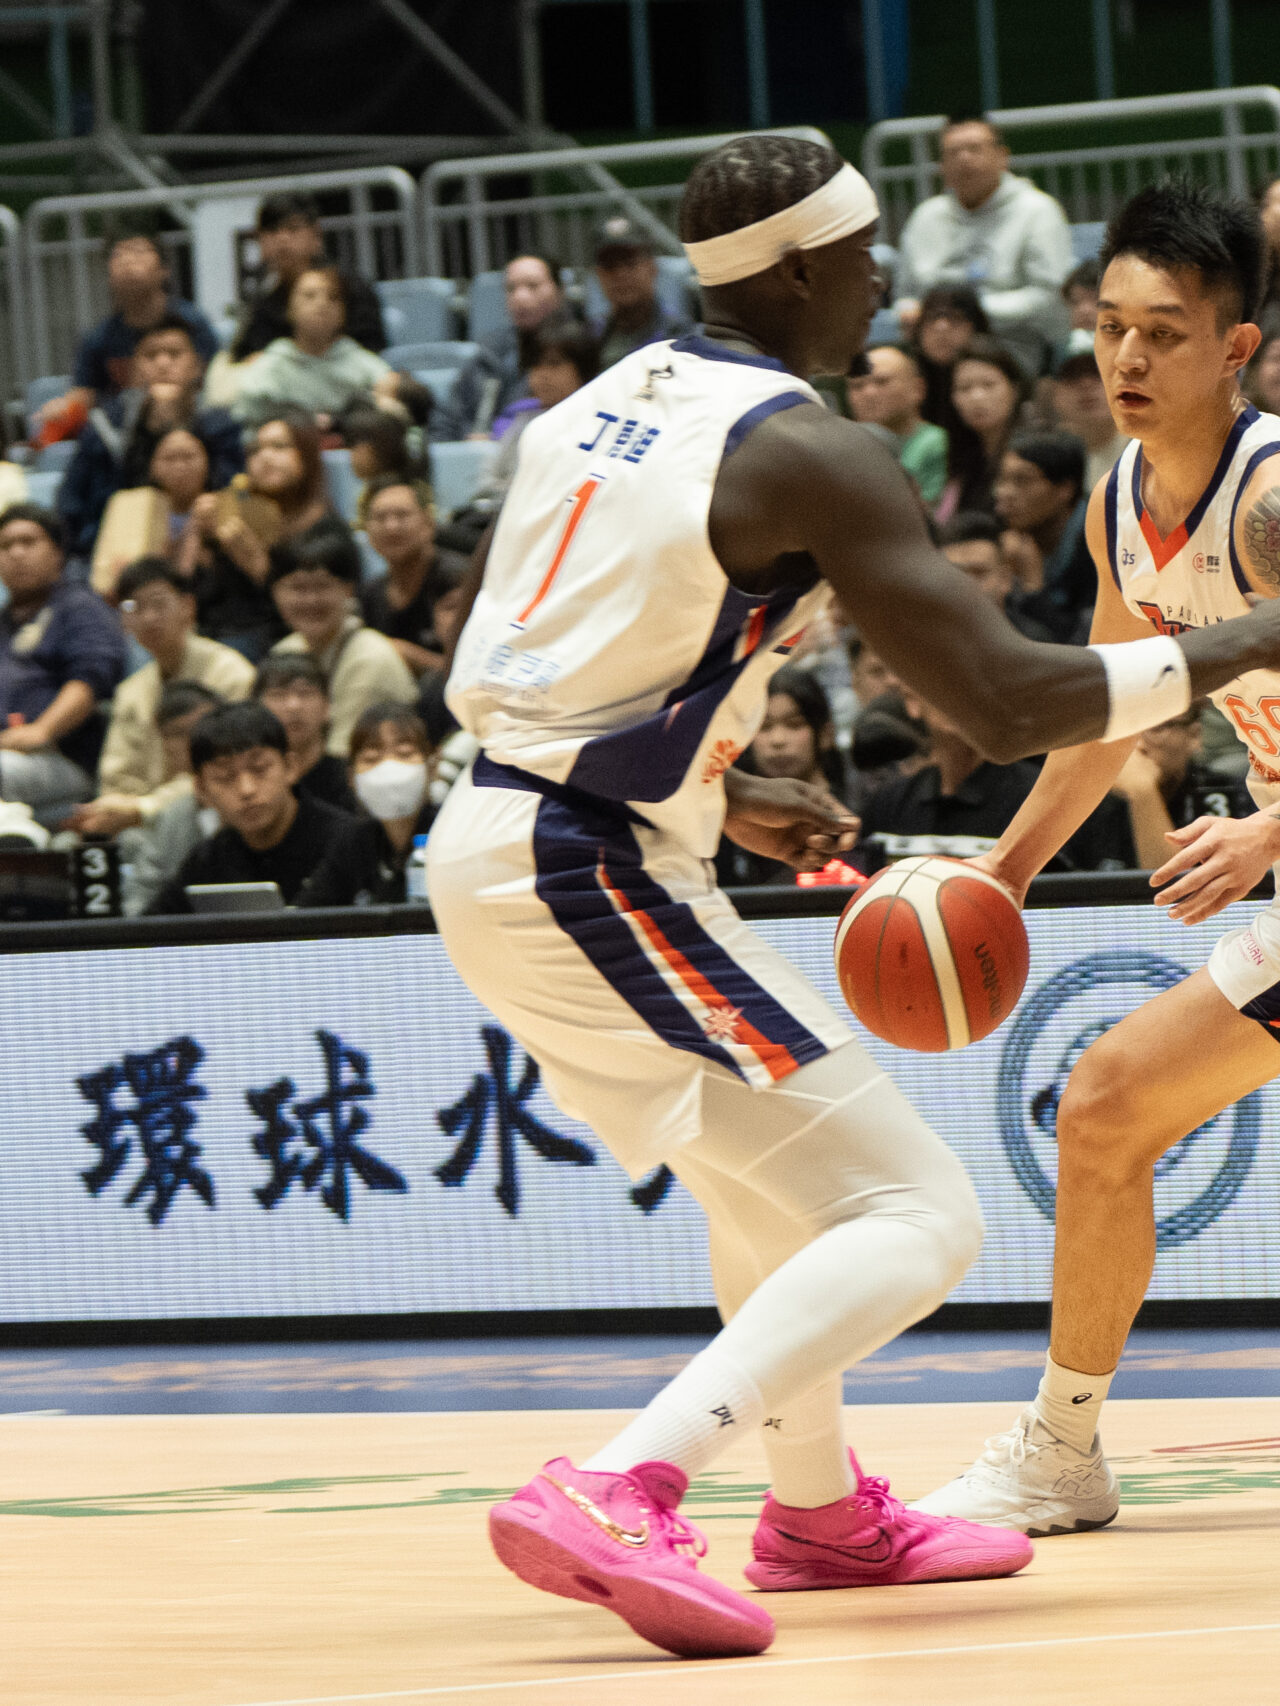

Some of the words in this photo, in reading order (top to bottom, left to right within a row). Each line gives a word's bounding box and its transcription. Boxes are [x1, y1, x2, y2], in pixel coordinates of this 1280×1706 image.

[511, 472, 607, 630] 1
[82, 847, 107, 878] 3
[84, 883, 111, 914] 2
[74, 1025, 676, 1226] 環球水
